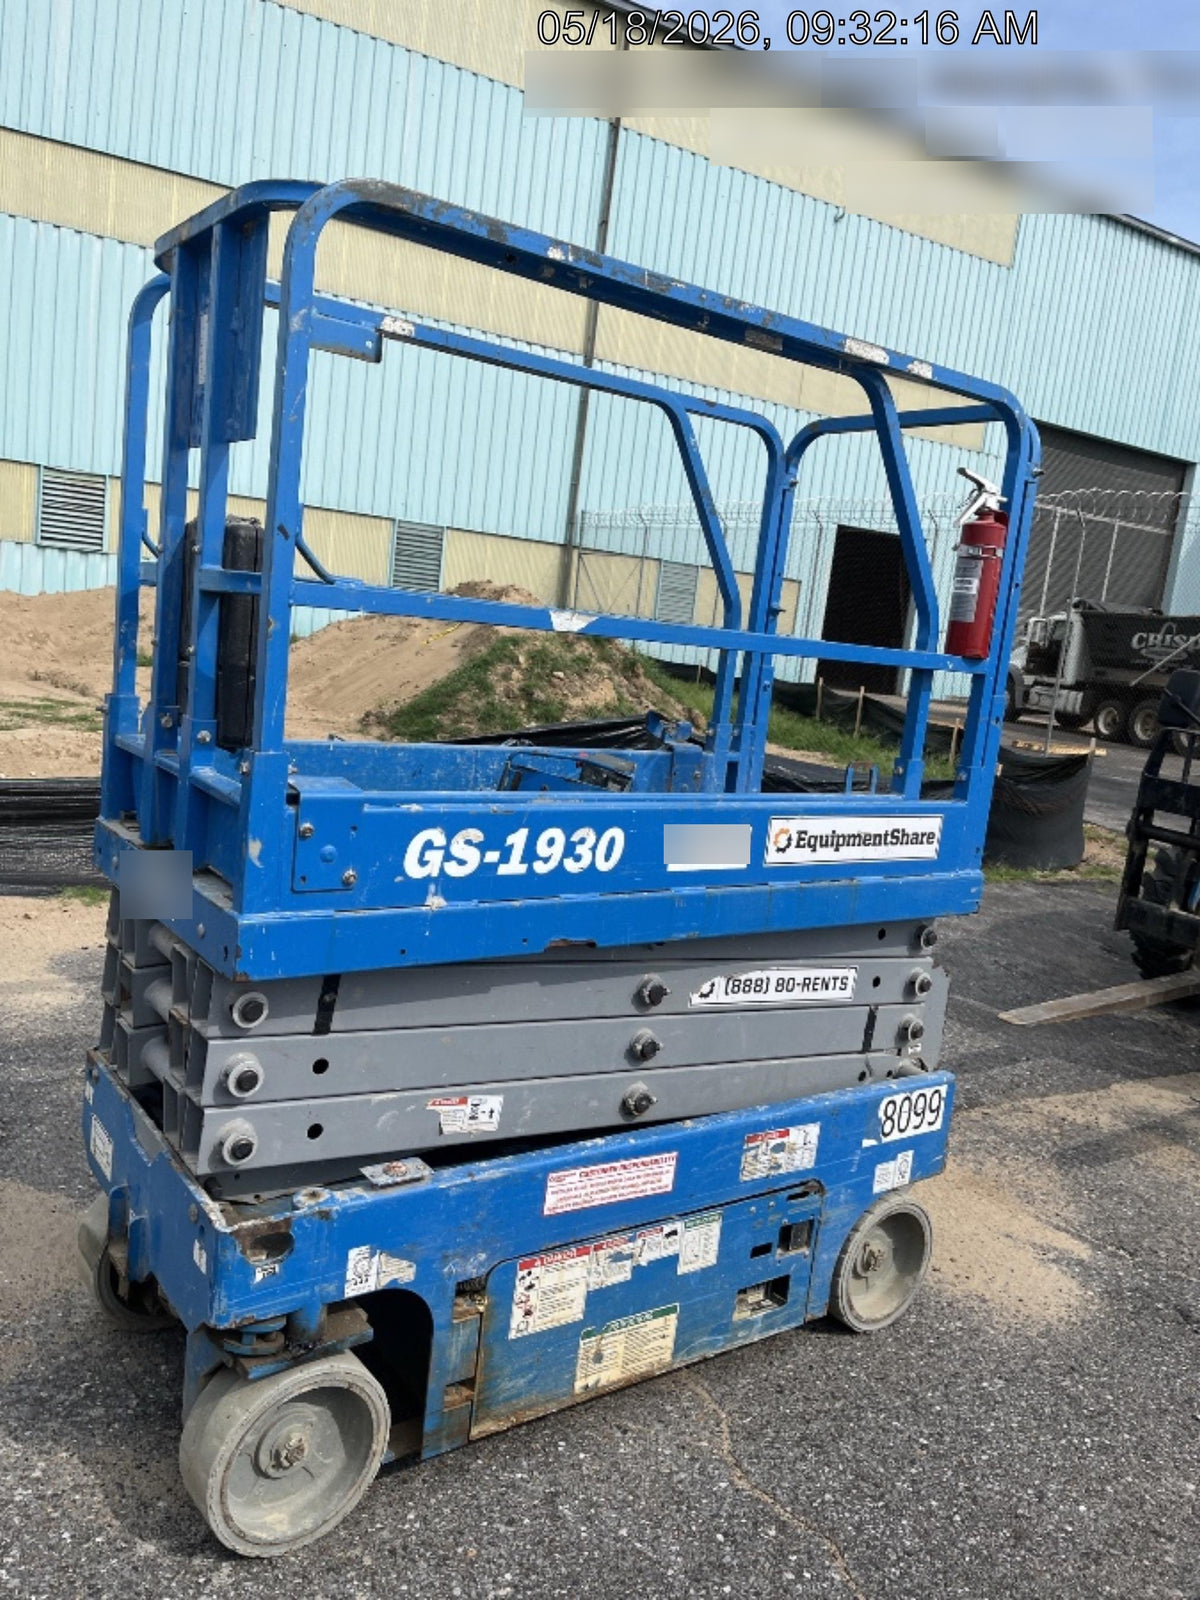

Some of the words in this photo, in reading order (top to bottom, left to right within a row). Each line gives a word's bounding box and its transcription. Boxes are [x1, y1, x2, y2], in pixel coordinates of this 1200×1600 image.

[403, 825, 626, 879] GS-1930
[794, 826, 937, 852] EquipmentShare
[724, 976, 771, 996] (888)
[775, 976, 849, 993] 80-RENTS
[881, 1089, 942, 1138] 8099
